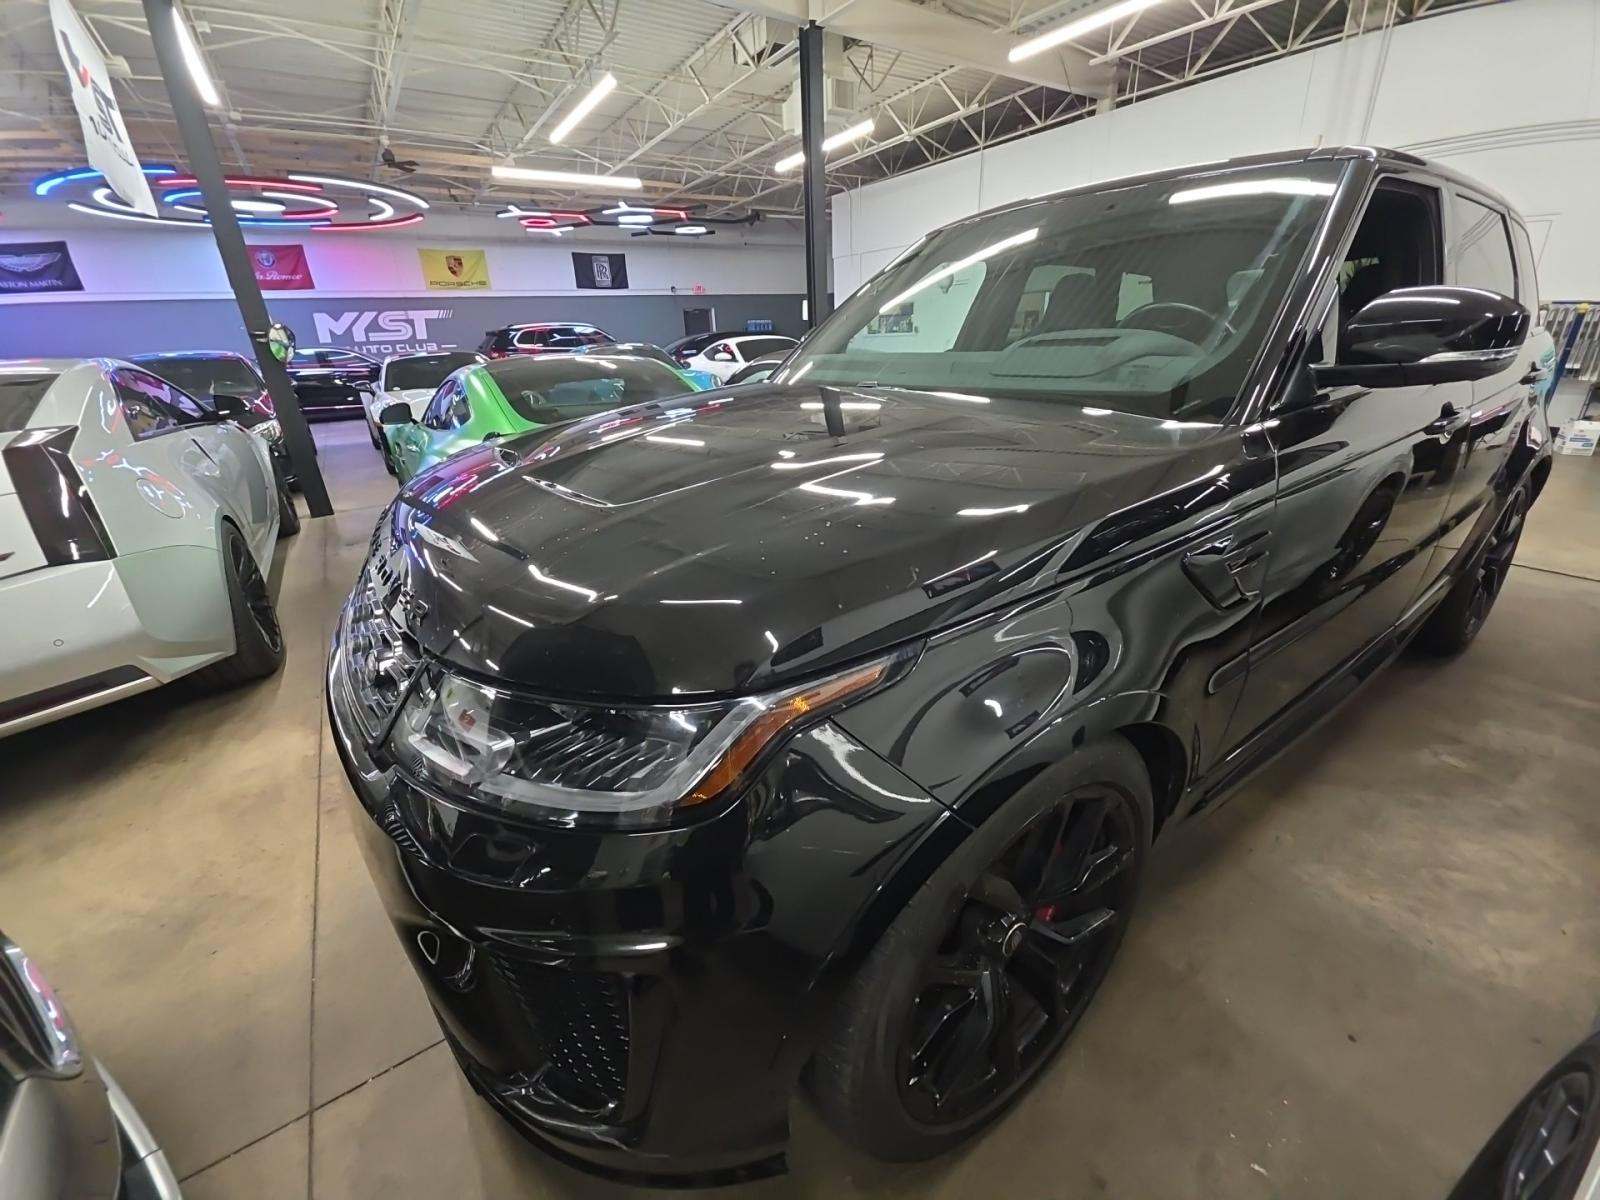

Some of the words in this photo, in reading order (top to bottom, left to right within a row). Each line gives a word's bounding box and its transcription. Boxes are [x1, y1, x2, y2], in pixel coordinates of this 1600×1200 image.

[266, 270, 303, 280] Romeo
[312, 309, 452, 343] MYST
[395, 342, 438, 352] CLUB
